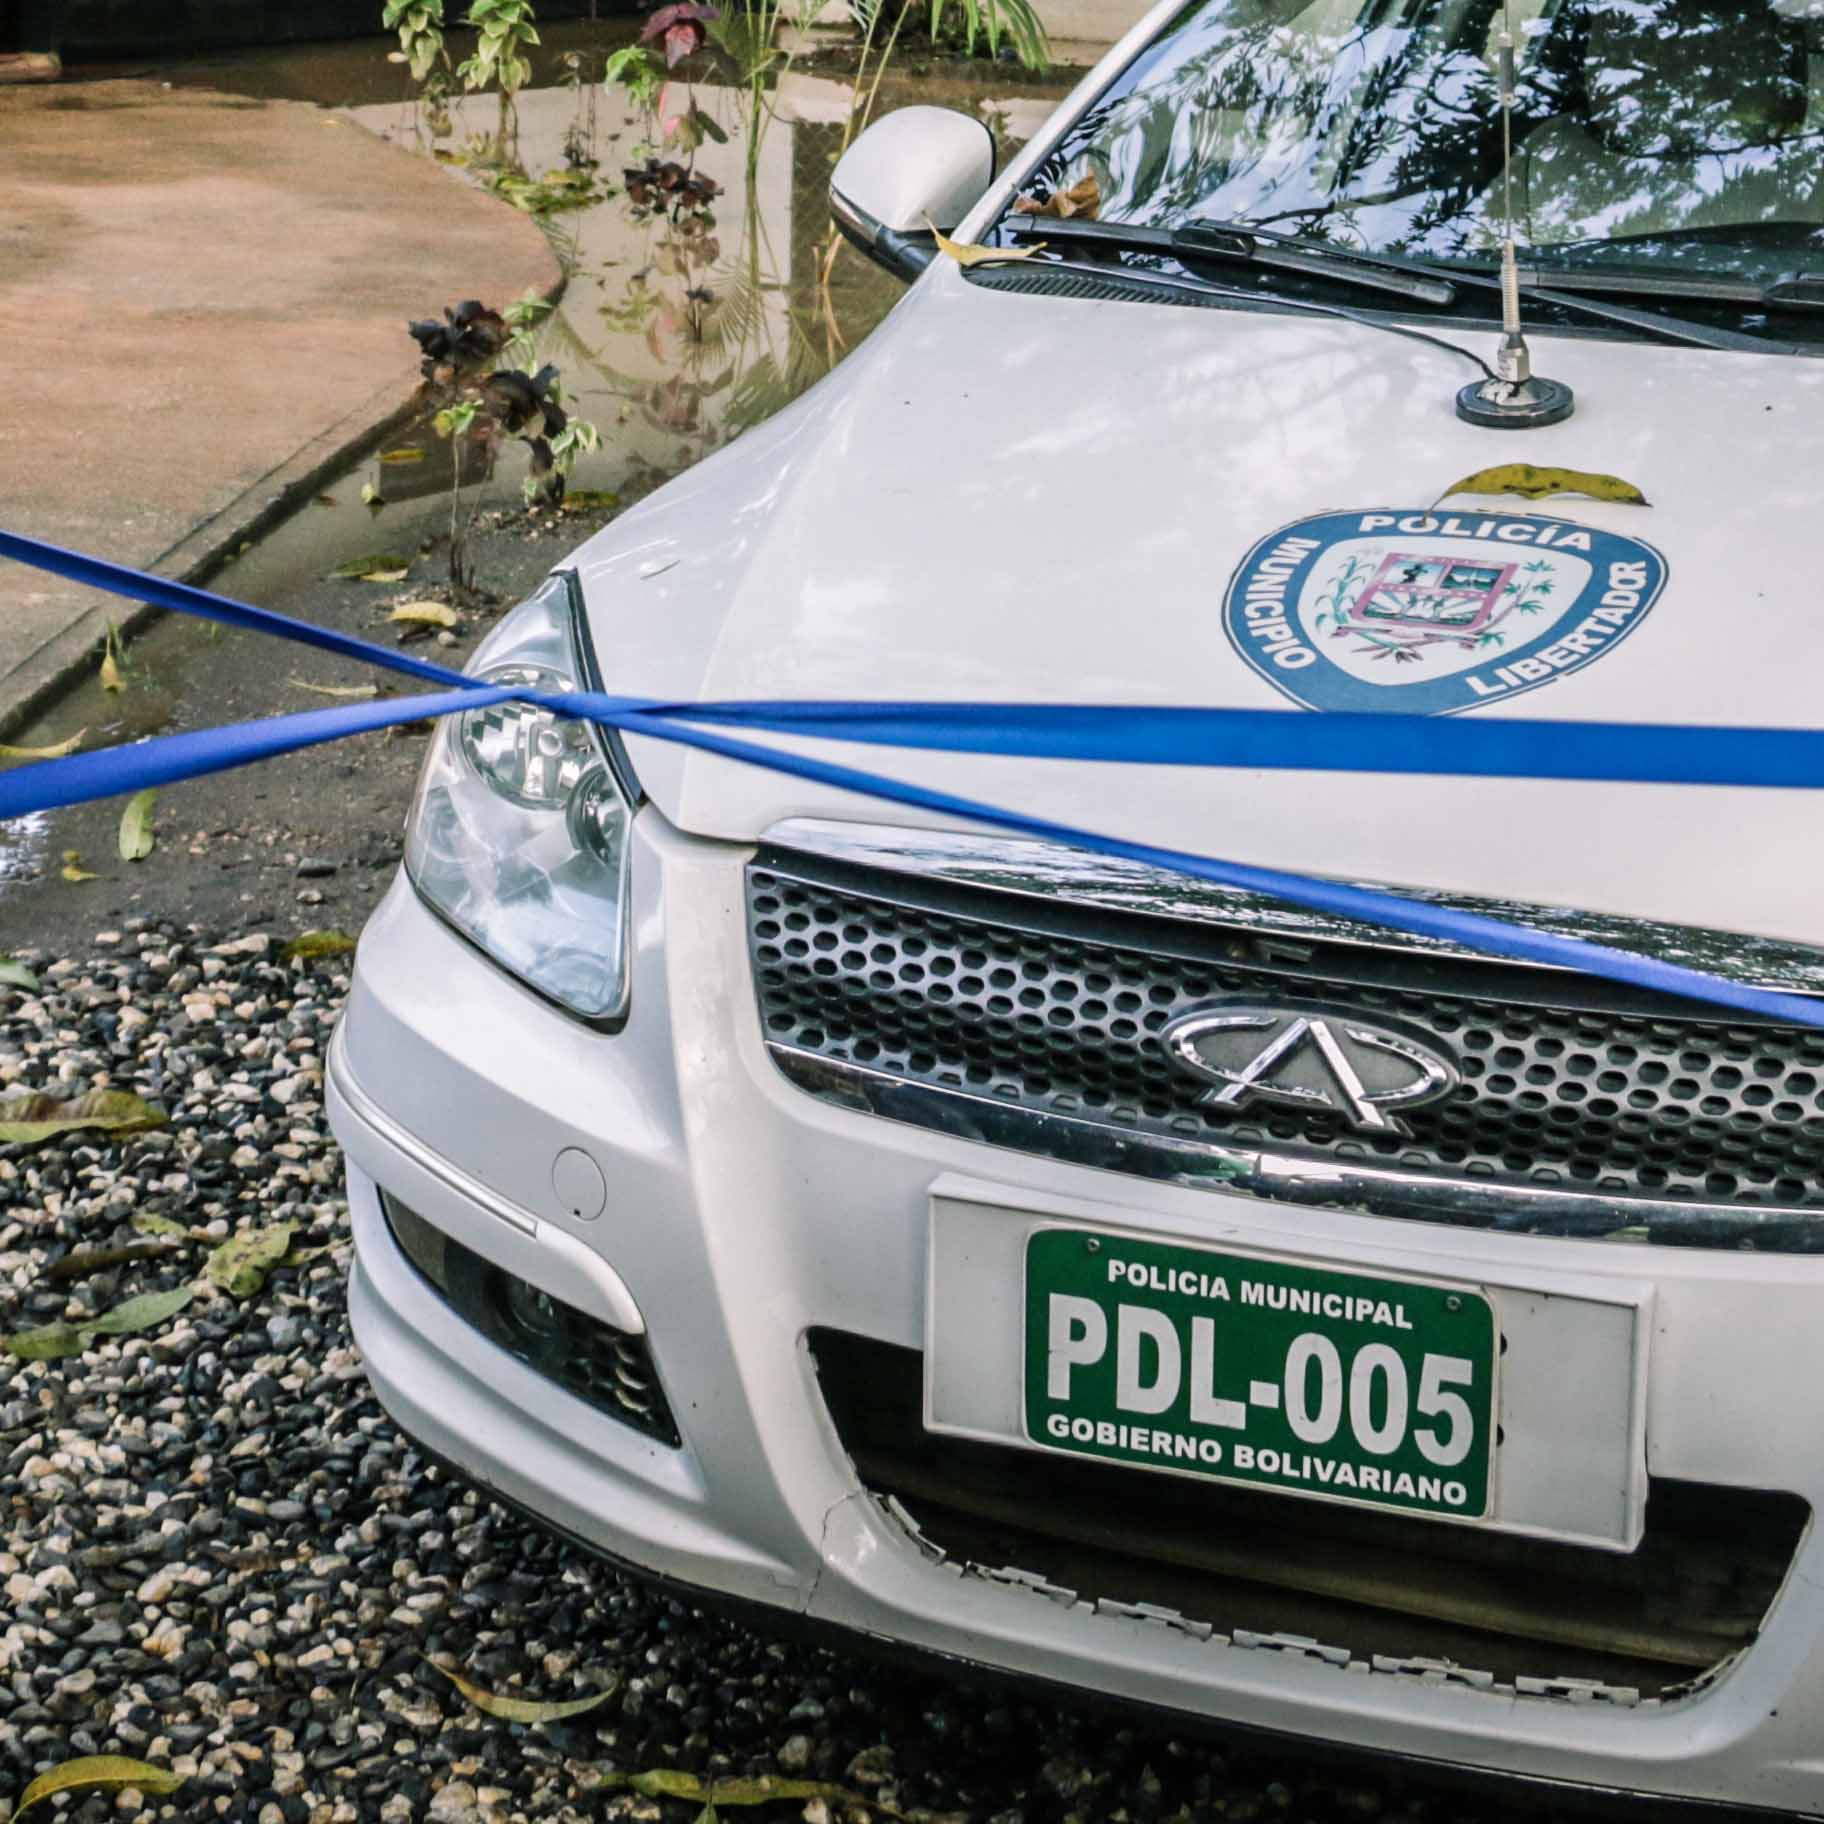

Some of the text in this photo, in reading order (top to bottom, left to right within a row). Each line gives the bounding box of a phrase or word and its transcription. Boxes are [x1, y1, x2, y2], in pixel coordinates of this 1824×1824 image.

[1358, 514, 1593, 552] POLICÍA
[1244, 536, 1322, 670] MUNICIPIO
[1465, 559, 1648, 697] LIBERTADOR
[1107, 1258, 1414, 1331] POLICIA MUNICIPAL
[1047, 1292, 1474, 1467] PDL-005
[1047, 1413, 1468, 1507] GOBIERNO BOLIVARIANO
